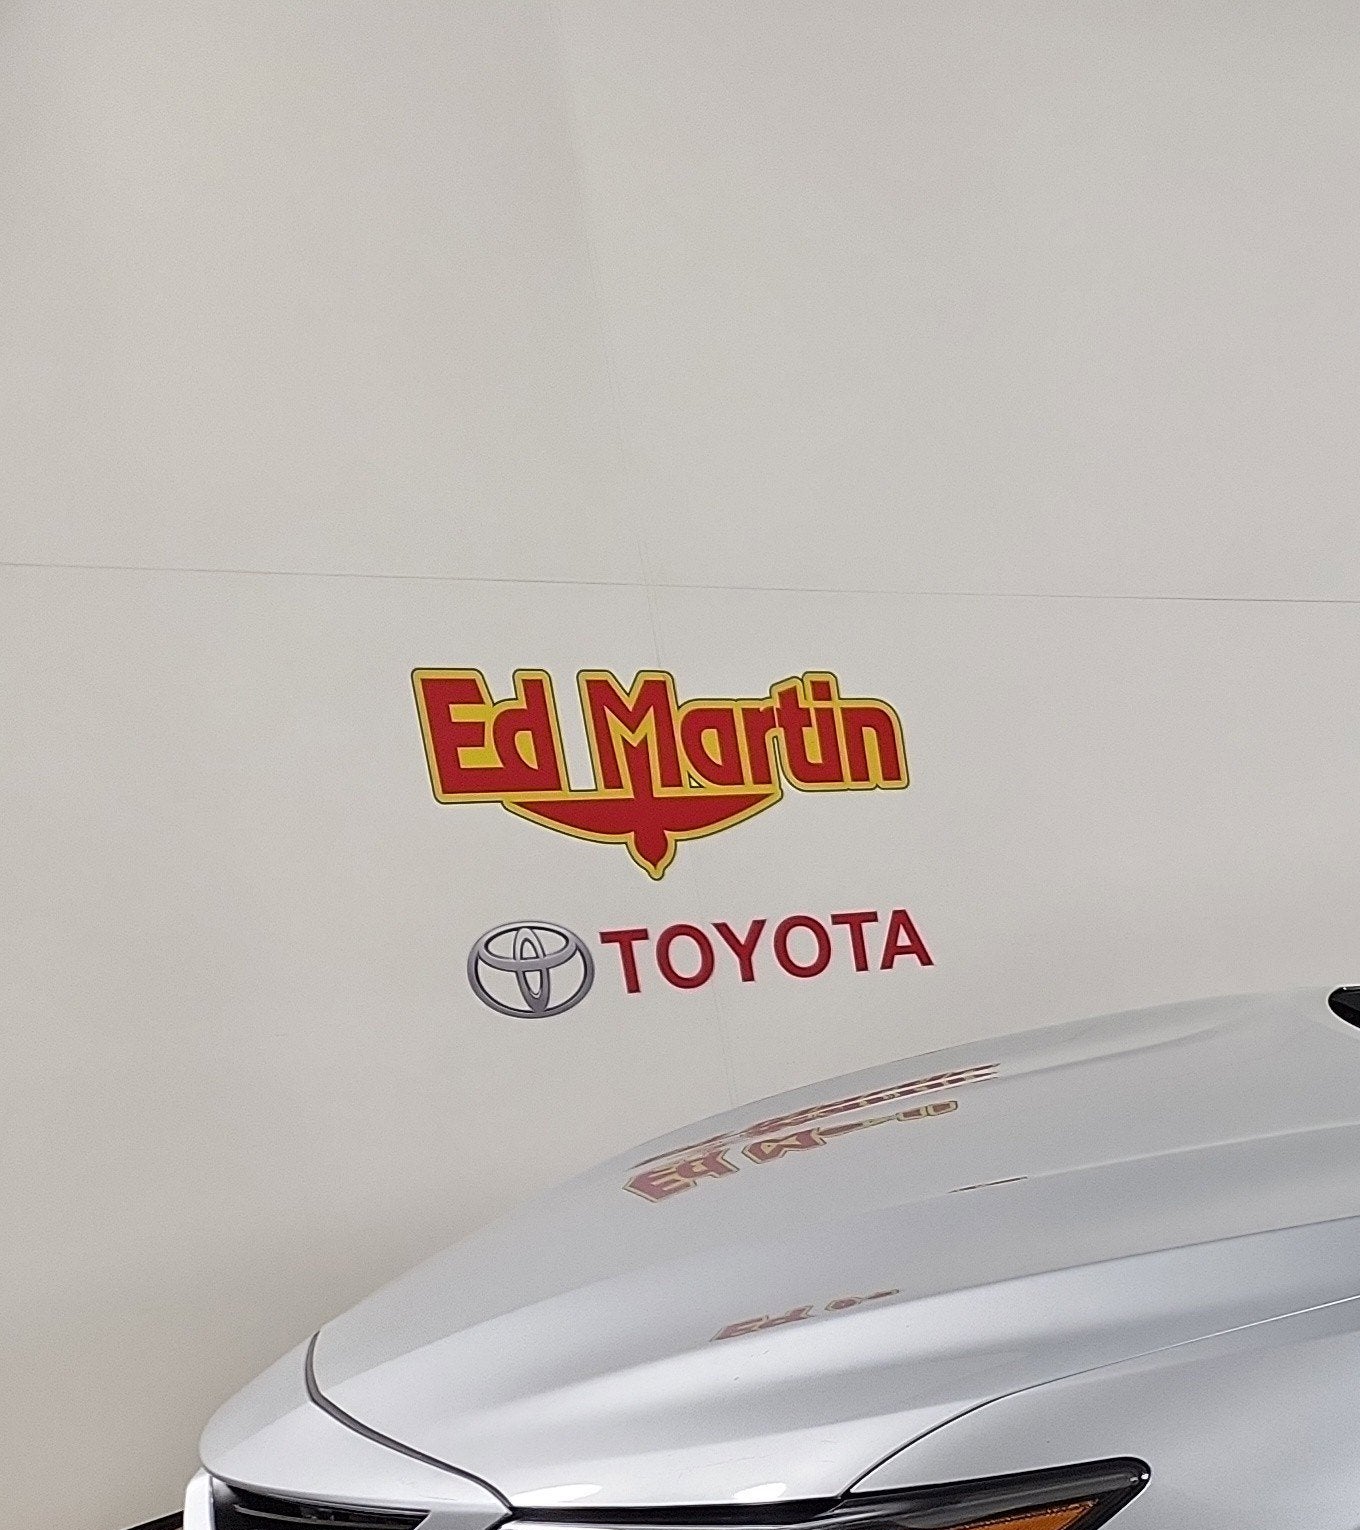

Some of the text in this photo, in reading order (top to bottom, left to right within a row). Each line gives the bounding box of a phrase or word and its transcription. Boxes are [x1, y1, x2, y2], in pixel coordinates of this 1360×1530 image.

[419, 676, 905, 795] Ed Martin
[599, 909, 935, 995] TOYOTA
